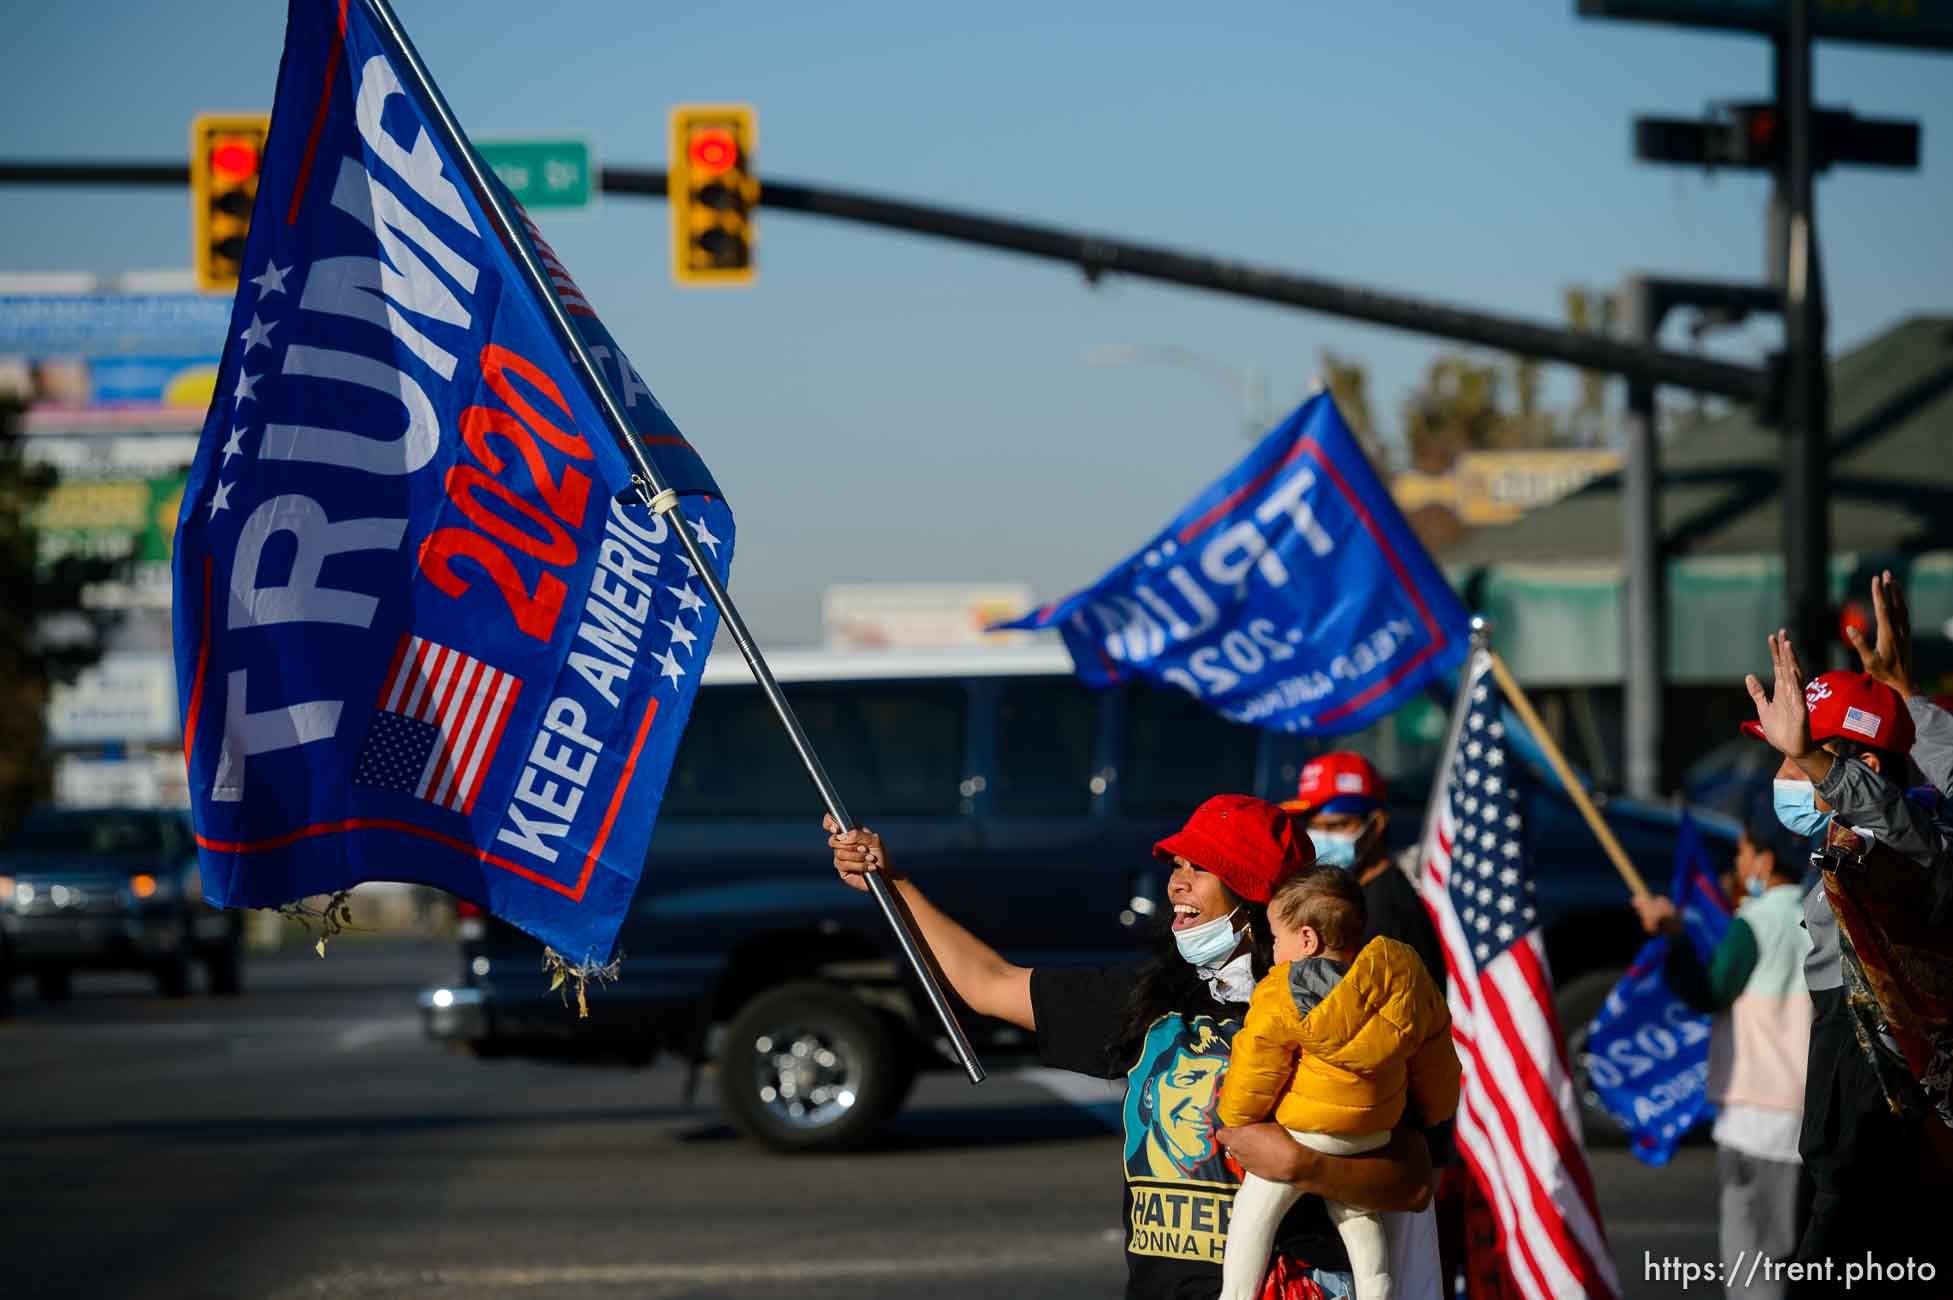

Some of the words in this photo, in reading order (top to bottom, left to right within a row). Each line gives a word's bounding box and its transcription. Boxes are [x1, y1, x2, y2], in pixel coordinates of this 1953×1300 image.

[210, 55, 482, 802] TRUMP
[418, 344, 596, 643] 2020
[497, 697, 603, 863] KEEP
[567, 495, 669, 707] AMERIC
